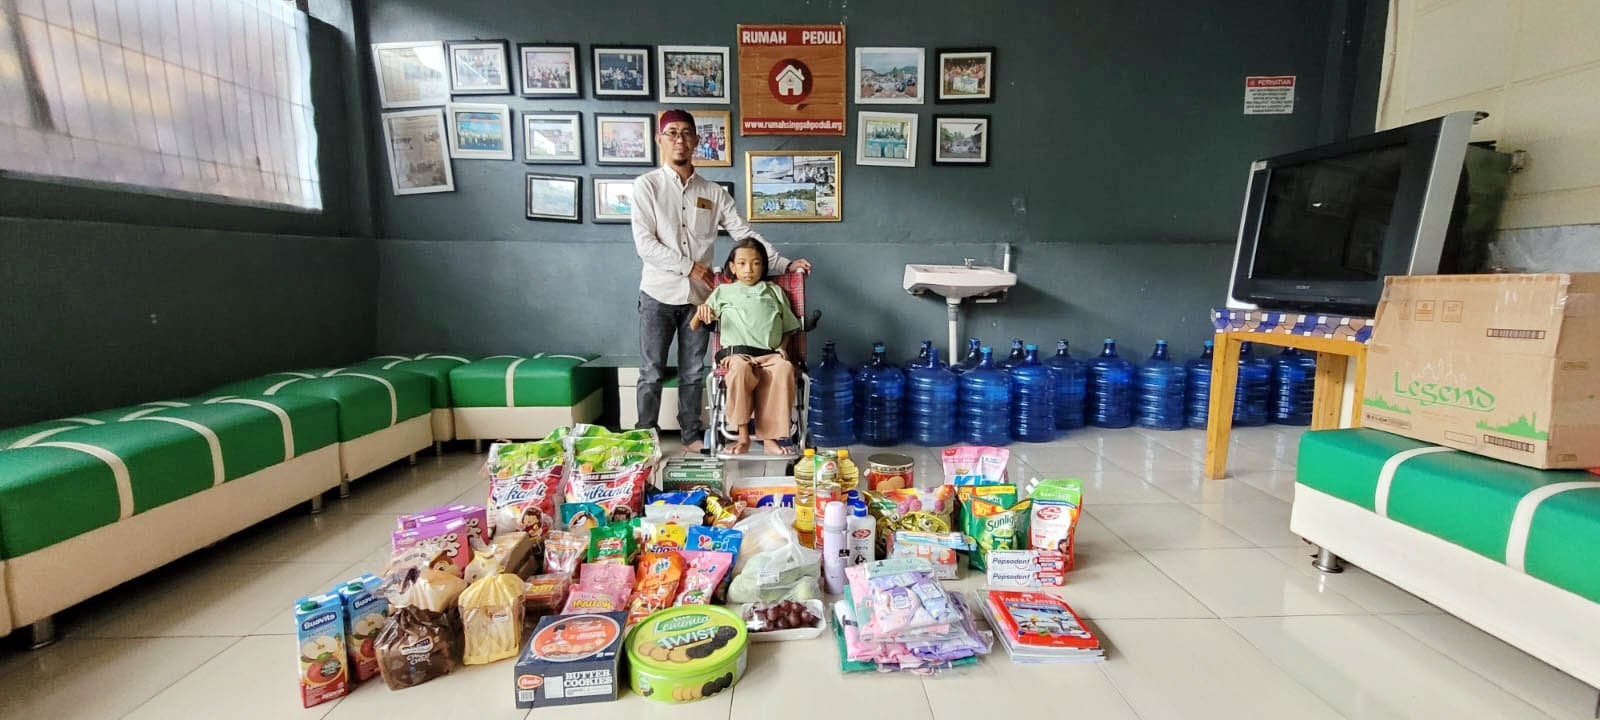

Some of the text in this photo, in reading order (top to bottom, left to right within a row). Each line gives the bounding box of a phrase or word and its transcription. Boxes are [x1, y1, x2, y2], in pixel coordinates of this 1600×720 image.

[742, 31, 842, 45] RUMAH PEDULI
[1393, 371, 1496, 410] Legend
[986, 515, 1014, 532] Sunlig
[657, 627, 716, 650] TWIST
[564, 677, 613, 687] COOKIES
[565, 669, 611, 680] BUTTER
